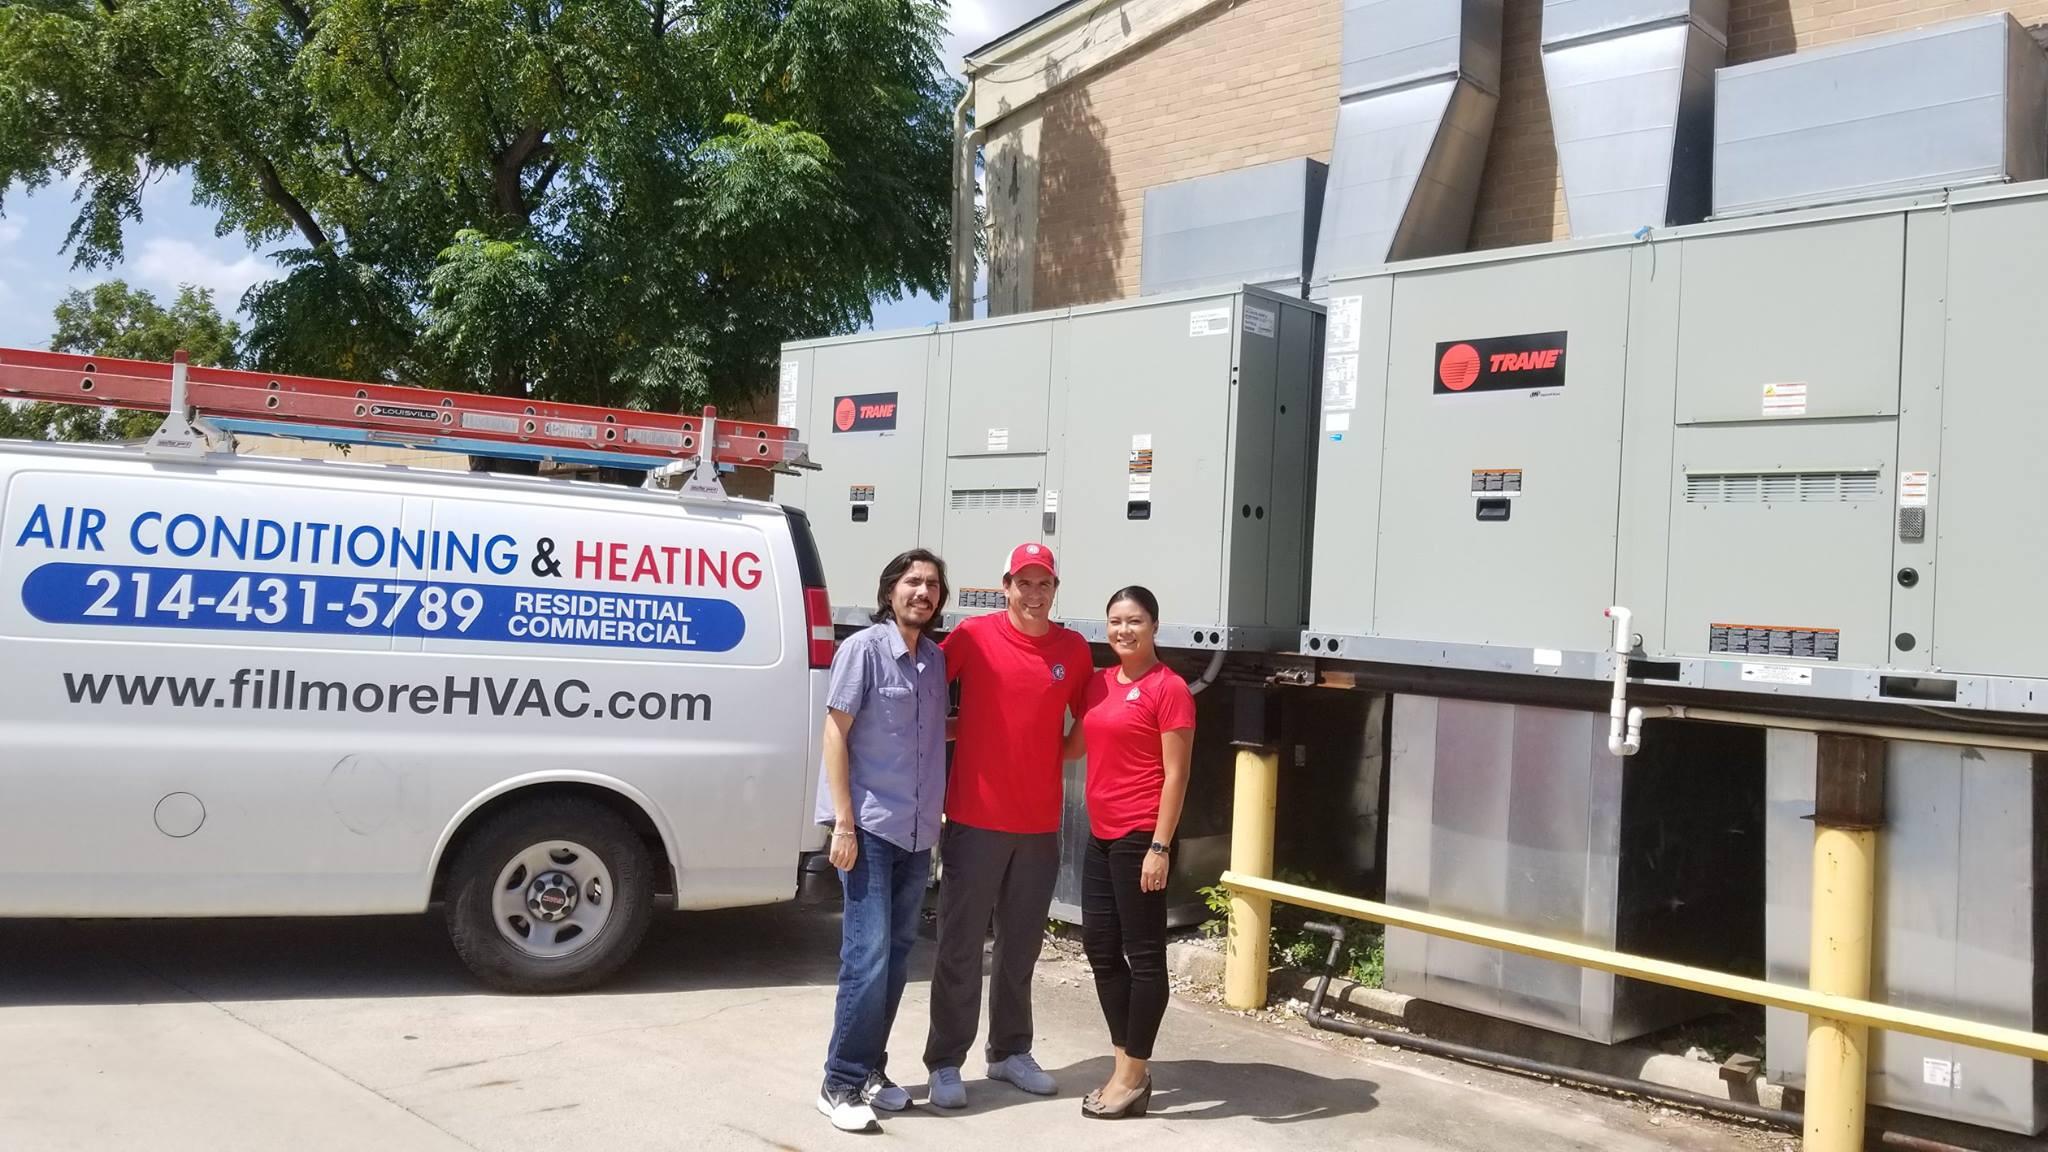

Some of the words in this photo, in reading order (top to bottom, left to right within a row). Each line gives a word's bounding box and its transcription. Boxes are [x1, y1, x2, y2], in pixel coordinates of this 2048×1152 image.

[1489, 349, 1559, 373] TRANE
[382, 407, 437, 418] LOUISVILLE
[860, 404, 894, 419] TRANE
[16, 503, 108, 552] AIR
[129, 511, 519, 576] CONDITIONING
[531, 537, 562, 578] &
[575, 540, 763, 591] HEATING
[83, 569, 484, 633] 214-431-5789
[515, 592, 692, 622] RESIDENTIAL
[508, 615, 696, 645] COMMERCIAL
[63, 668, 712, 721] www.fillmoreHVAC.com
